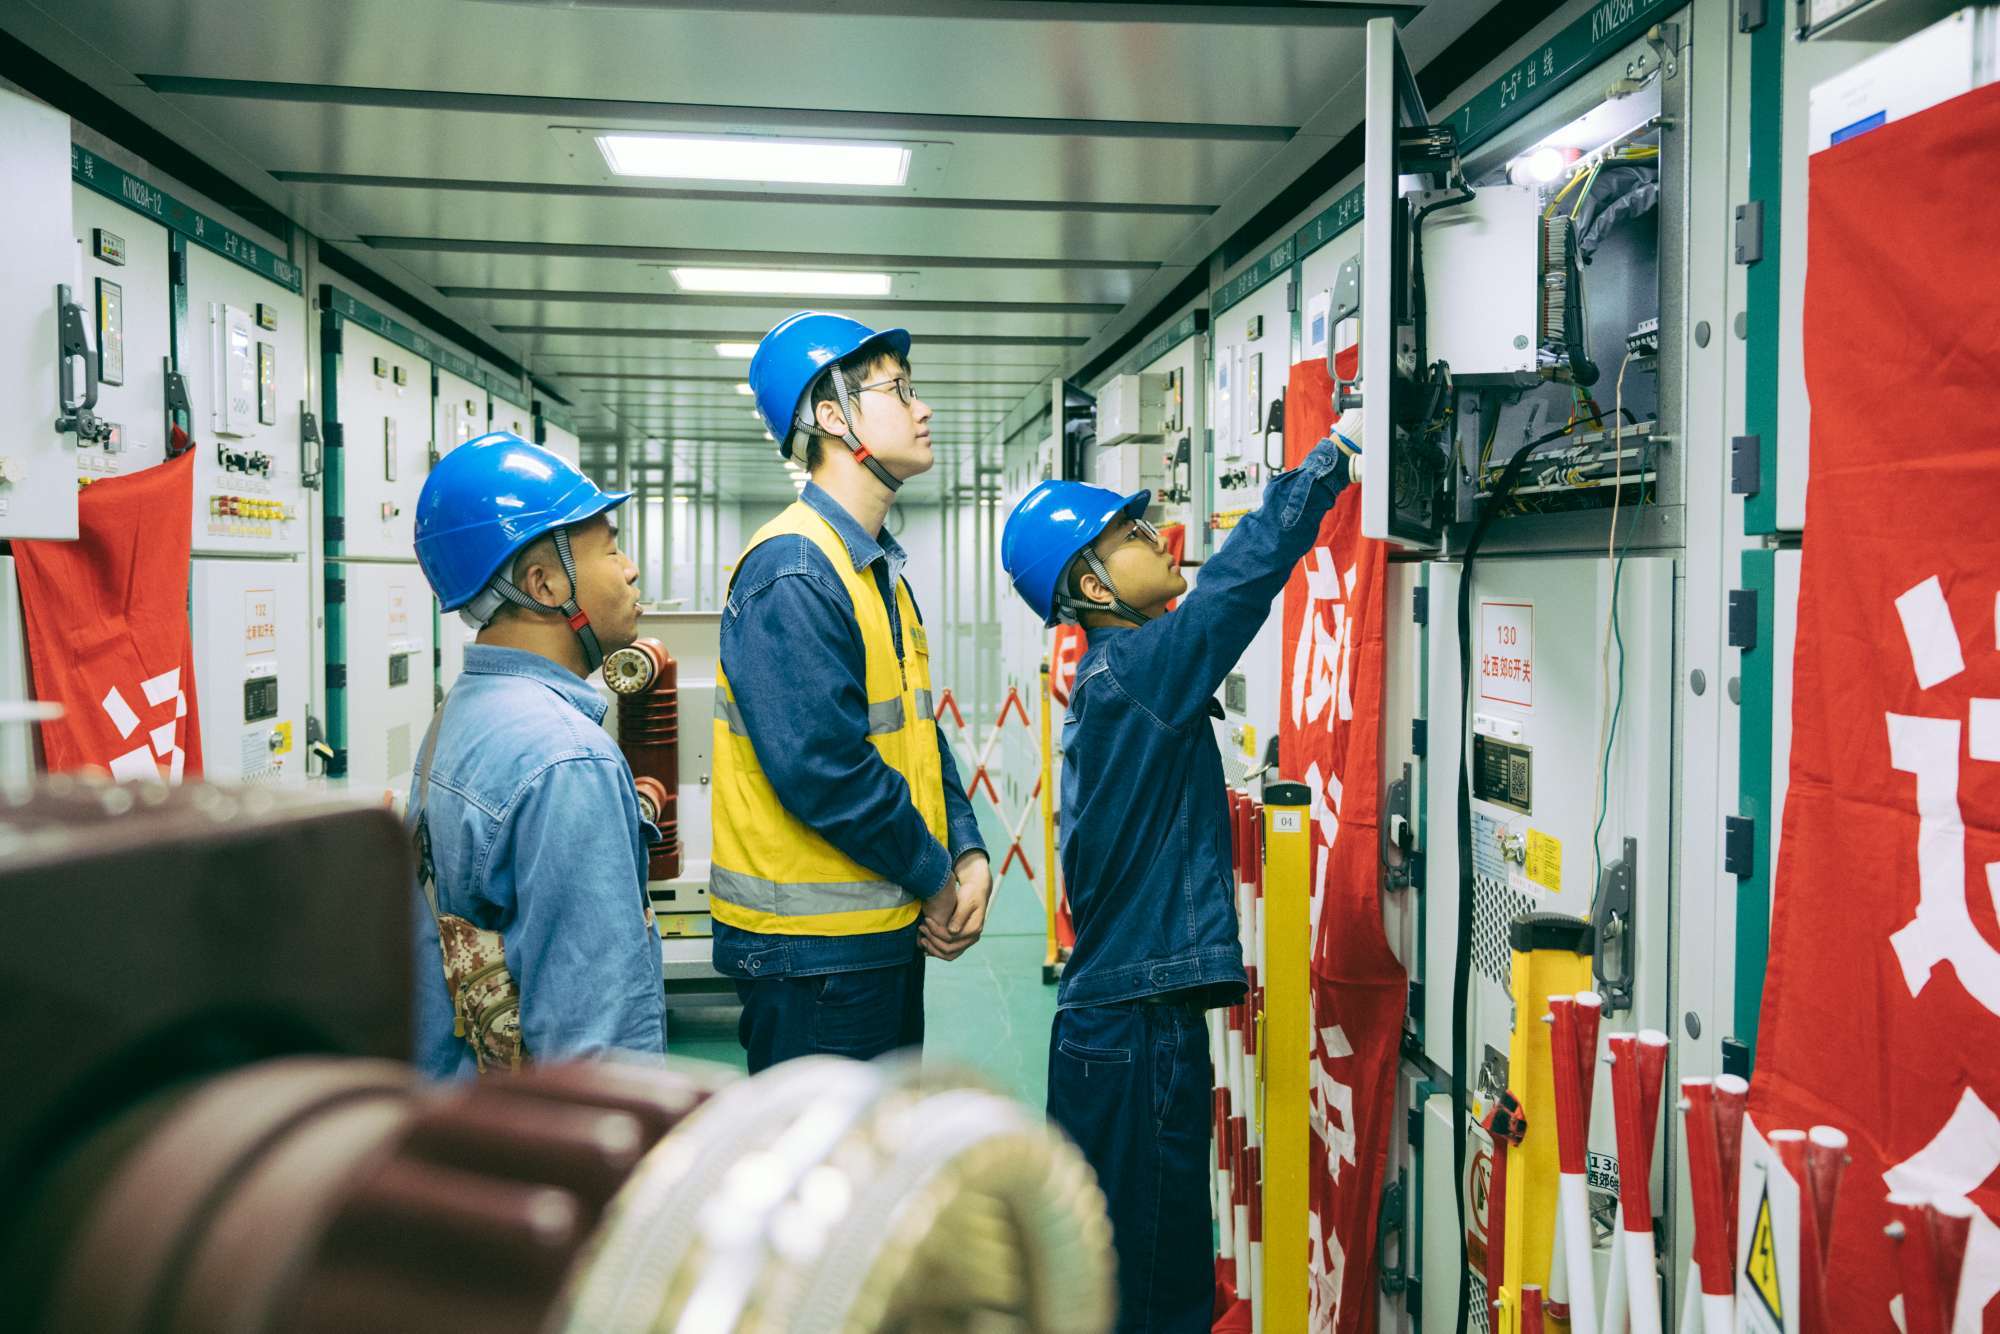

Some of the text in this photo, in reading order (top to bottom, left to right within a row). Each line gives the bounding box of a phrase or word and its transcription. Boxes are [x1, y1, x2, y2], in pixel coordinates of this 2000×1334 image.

[1464, 107, 1471, 132] 7
[123, 175, 162, 215] KYN28A-12
[1498, 625, 1517, 645] 130
[1281, 817, 1292, 827] 04
[1591, 1156, 1619, 1175] 130
